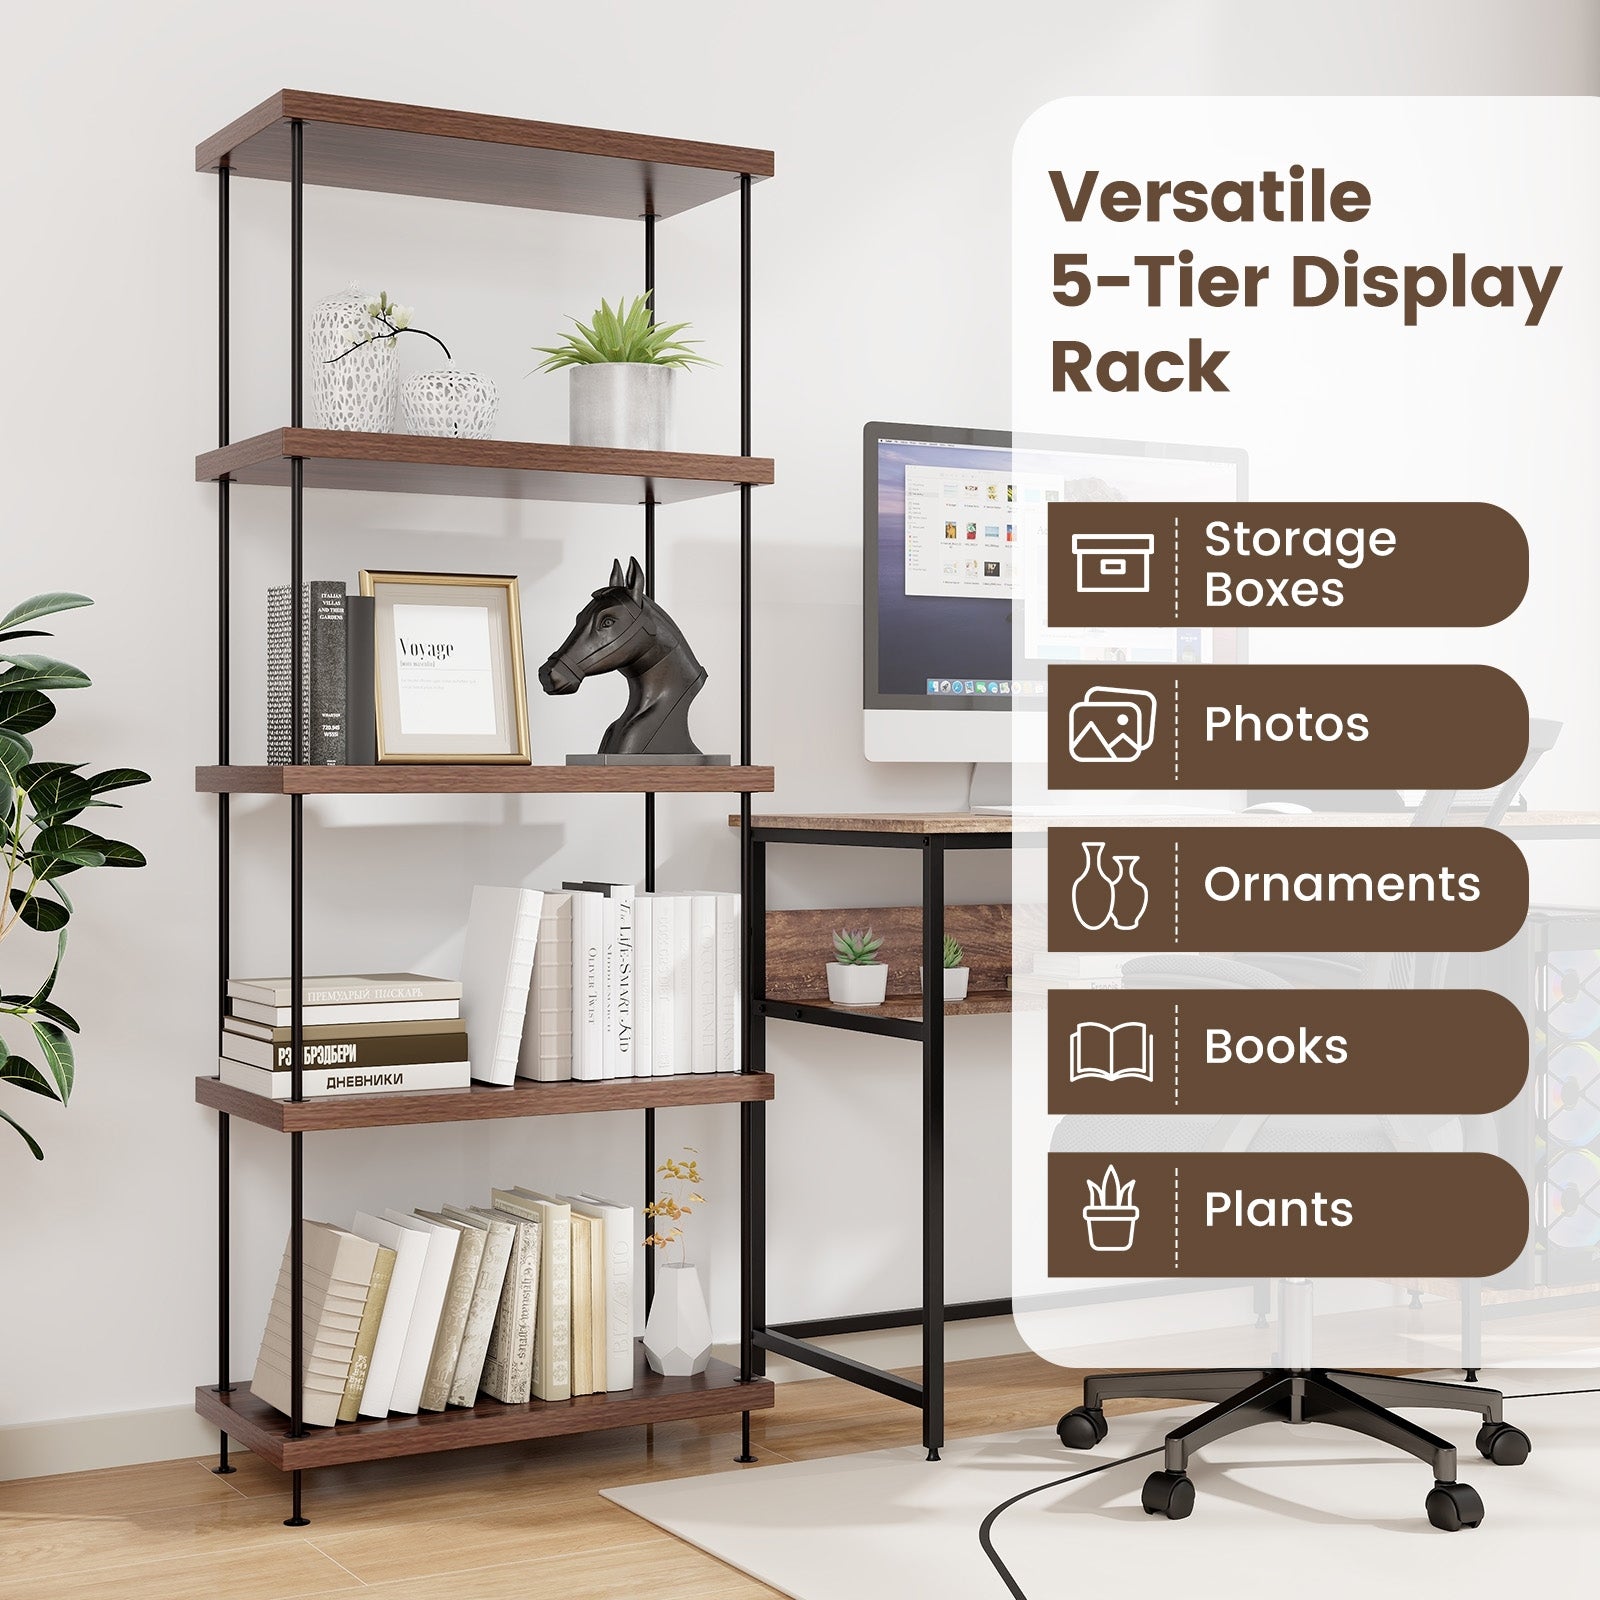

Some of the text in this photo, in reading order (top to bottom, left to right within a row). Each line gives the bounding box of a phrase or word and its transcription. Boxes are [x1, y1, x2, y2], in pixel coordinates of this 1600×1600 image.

[400, 638, 454, 660] Voyage
[308, 987, 371, 1003] ПРЕМУДРЫЙ
[304, 1043, 357, 1066] БРЭДБЕРИ
[326, 1073, 403, 1090] ДНЕВНИКИ
